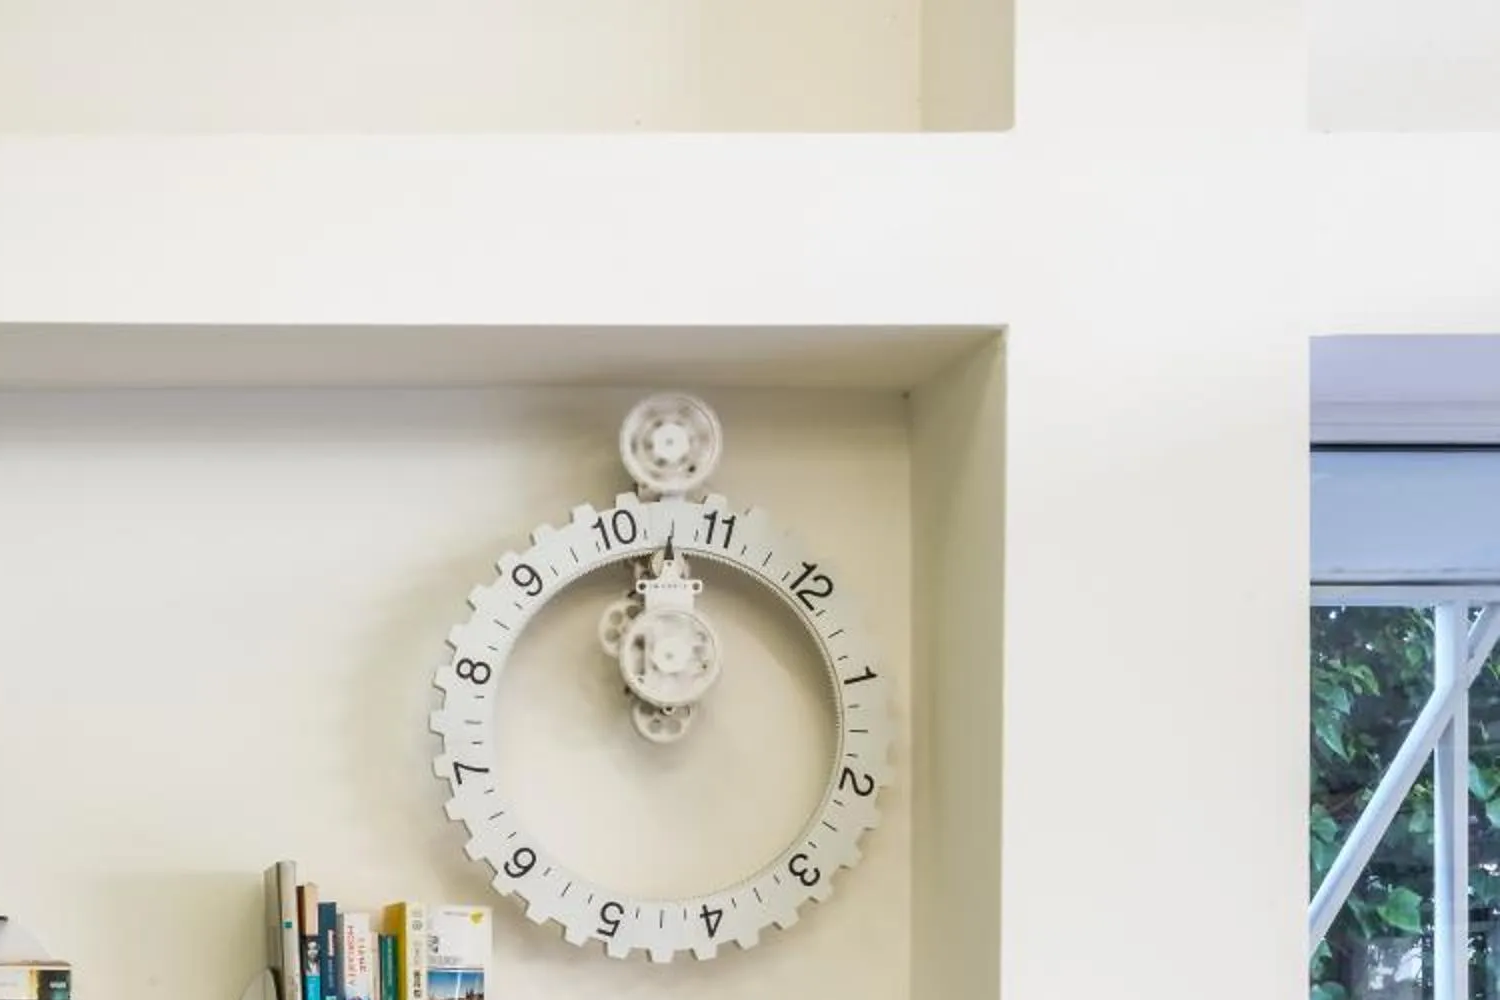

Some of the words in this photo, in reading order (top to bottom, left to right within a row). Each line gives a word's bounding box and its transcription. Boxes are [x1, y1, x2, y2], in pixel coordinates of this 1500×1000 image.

[591, 509, 638, 550] 10
[702, 510, 738, 549] 11
[511, 563, 543, 597] 9
[789, 561, 834, 611] 12
[456, 658, 491, 685] 8
[843, 666, 878, 686] 1
[453, 761, 490, 785] 7
[838, 767, 875, 797] 2
[503, 847, 537, 880] 6
[788, 853, 821, 887] 3
[597, 901, 625, 938] 5
[700, 904, 724, 939] 4
